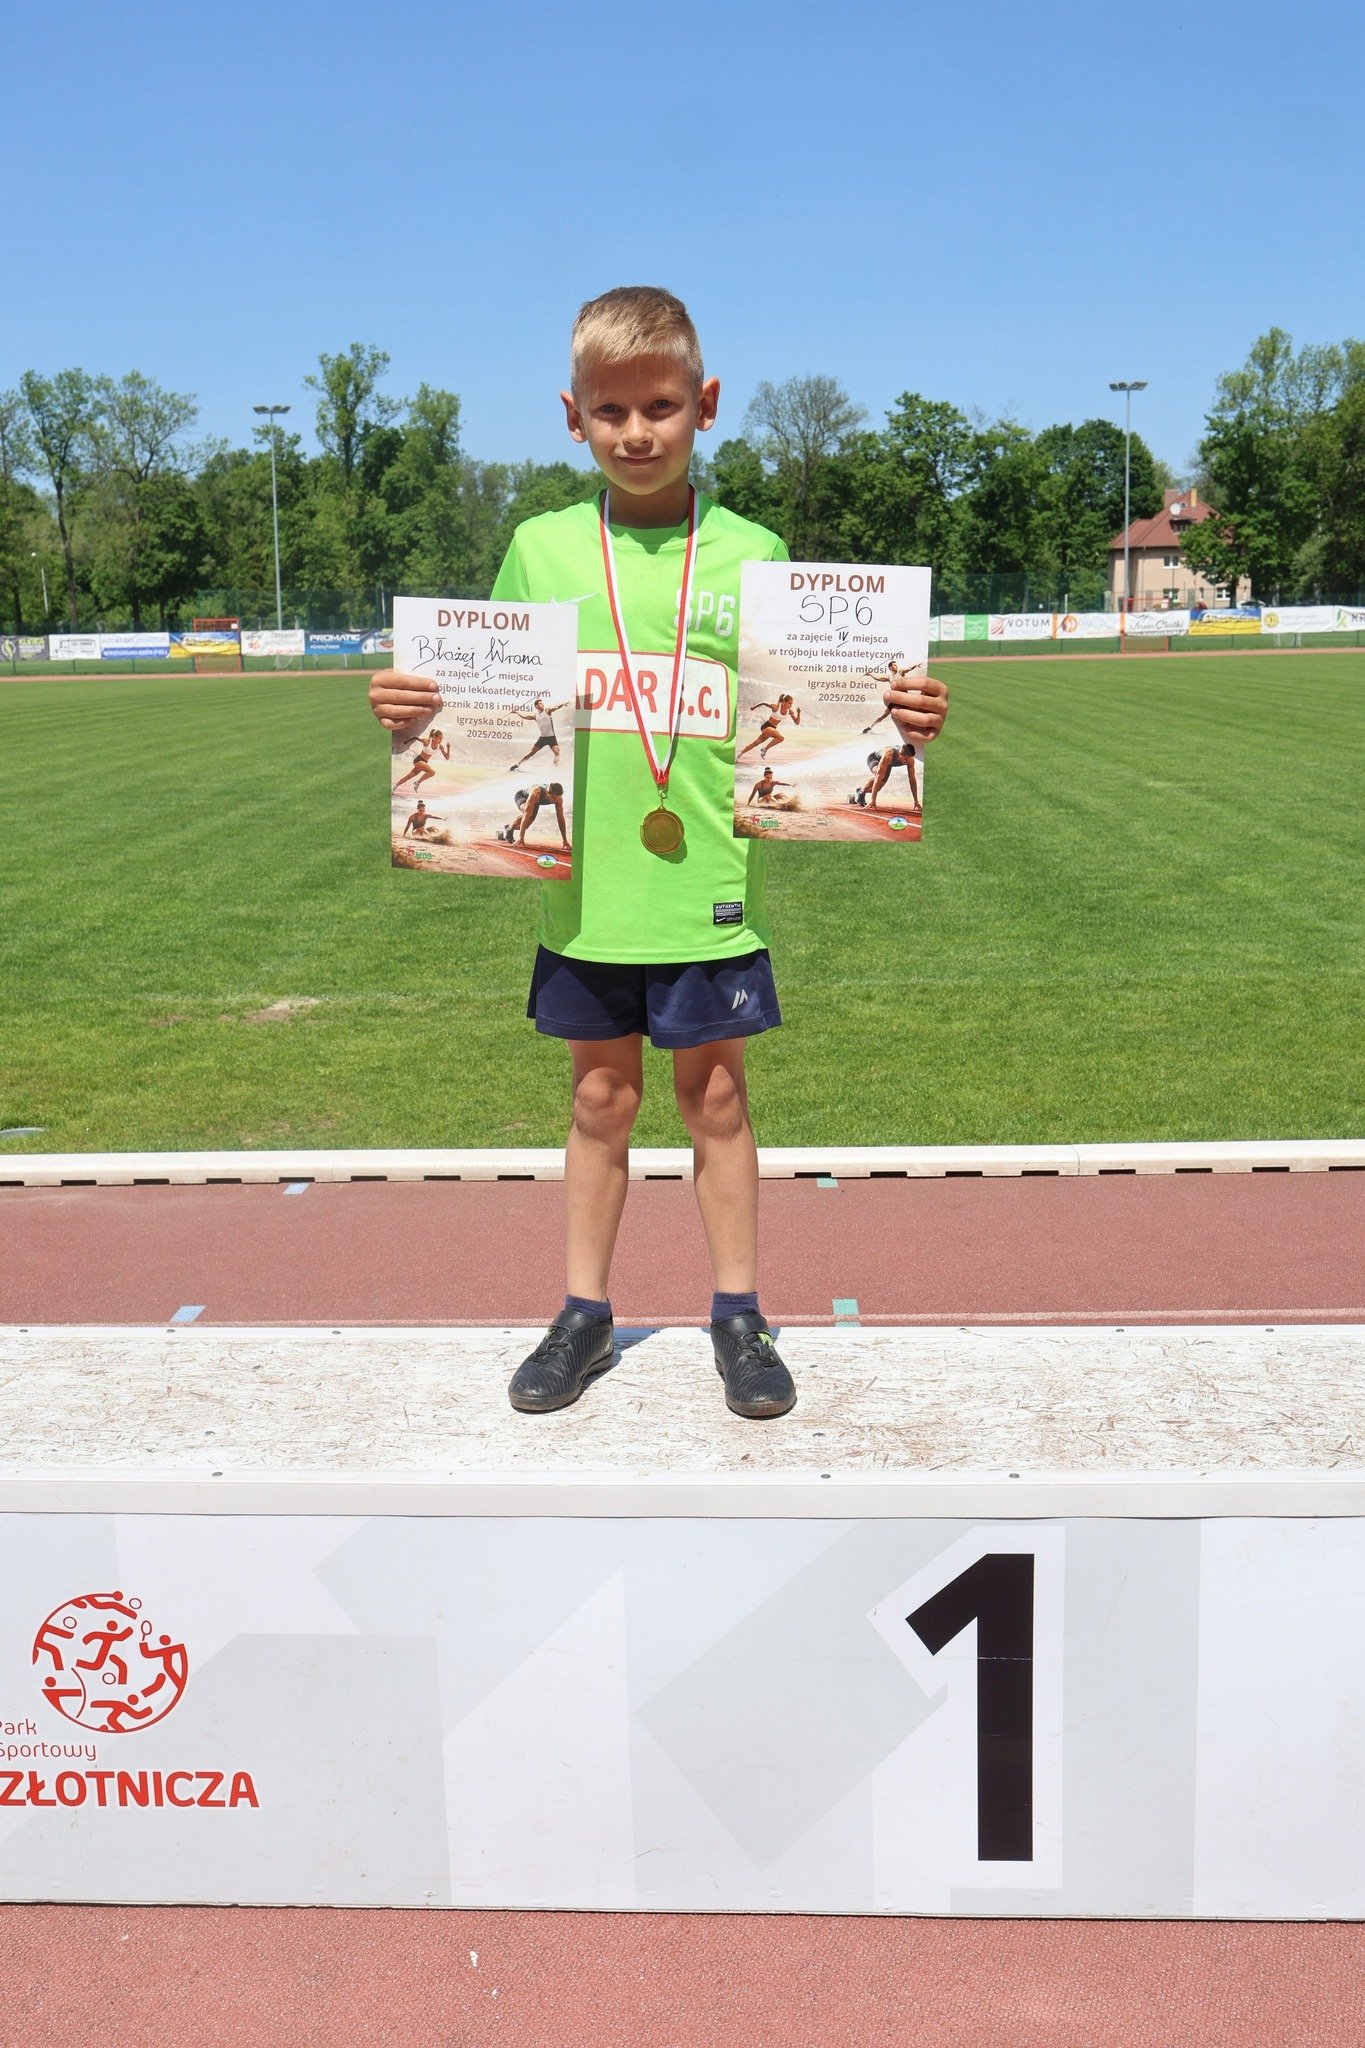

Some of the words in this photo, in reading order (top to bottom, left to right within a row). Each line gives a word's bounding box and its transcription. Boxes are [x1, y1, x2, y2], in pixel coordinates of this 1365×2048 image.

[790, 572, 885, 593] DYPLOM
[674, 588, 736, 637] SP6
[799, 594, 873, 626] SP6
[437, 609, 530, 631] DYPLOM
[1008, 619, 1049, 627] VOTUM
[309, 633, 361, 642] PROMATIC
[787, 633, 798, 641] za
[799, 632, 833, 643] zajęcie
[852, 634, 889, 645] miejsca
[411, 635, 476, 672] Błażej
[769, 648, 778, 656] w
[779, 647, 819, 659] trójboju
[820, 649, 905, 661] lekkoatletycznym
[435, 669, 446, 677] za
[448, 668, 480, 680] zajęcie
[498, 672, 534, 682] miejsca
[788, 664, 824, 673] rocznik
[826, 664, 848, 673] 2018
[855, 665, 887, 675] młodsi
[807, 679, 847, 690] Igrzyska
[849, 681, 877, 690] Dzieci
[468, 685, 551, 699] lekkoatletycznym
[818, 693, 866, 703] 2025/2026
[442, 700, 471, 709] ocznik
[473, 701, 495, 711] 2018
[502, 702, 534, 712] młodsi
[456, 716, 494, 727] Igrzyska
[496, 718, 524, 728] Dzieci
[466, 729, 513, 740] 2025/2026
[905, 1553, 1034, 1862] 1
[0, 1718, 37, 1735] ark
[0, 1771, 260, 1808] ZŁOTNICZA
